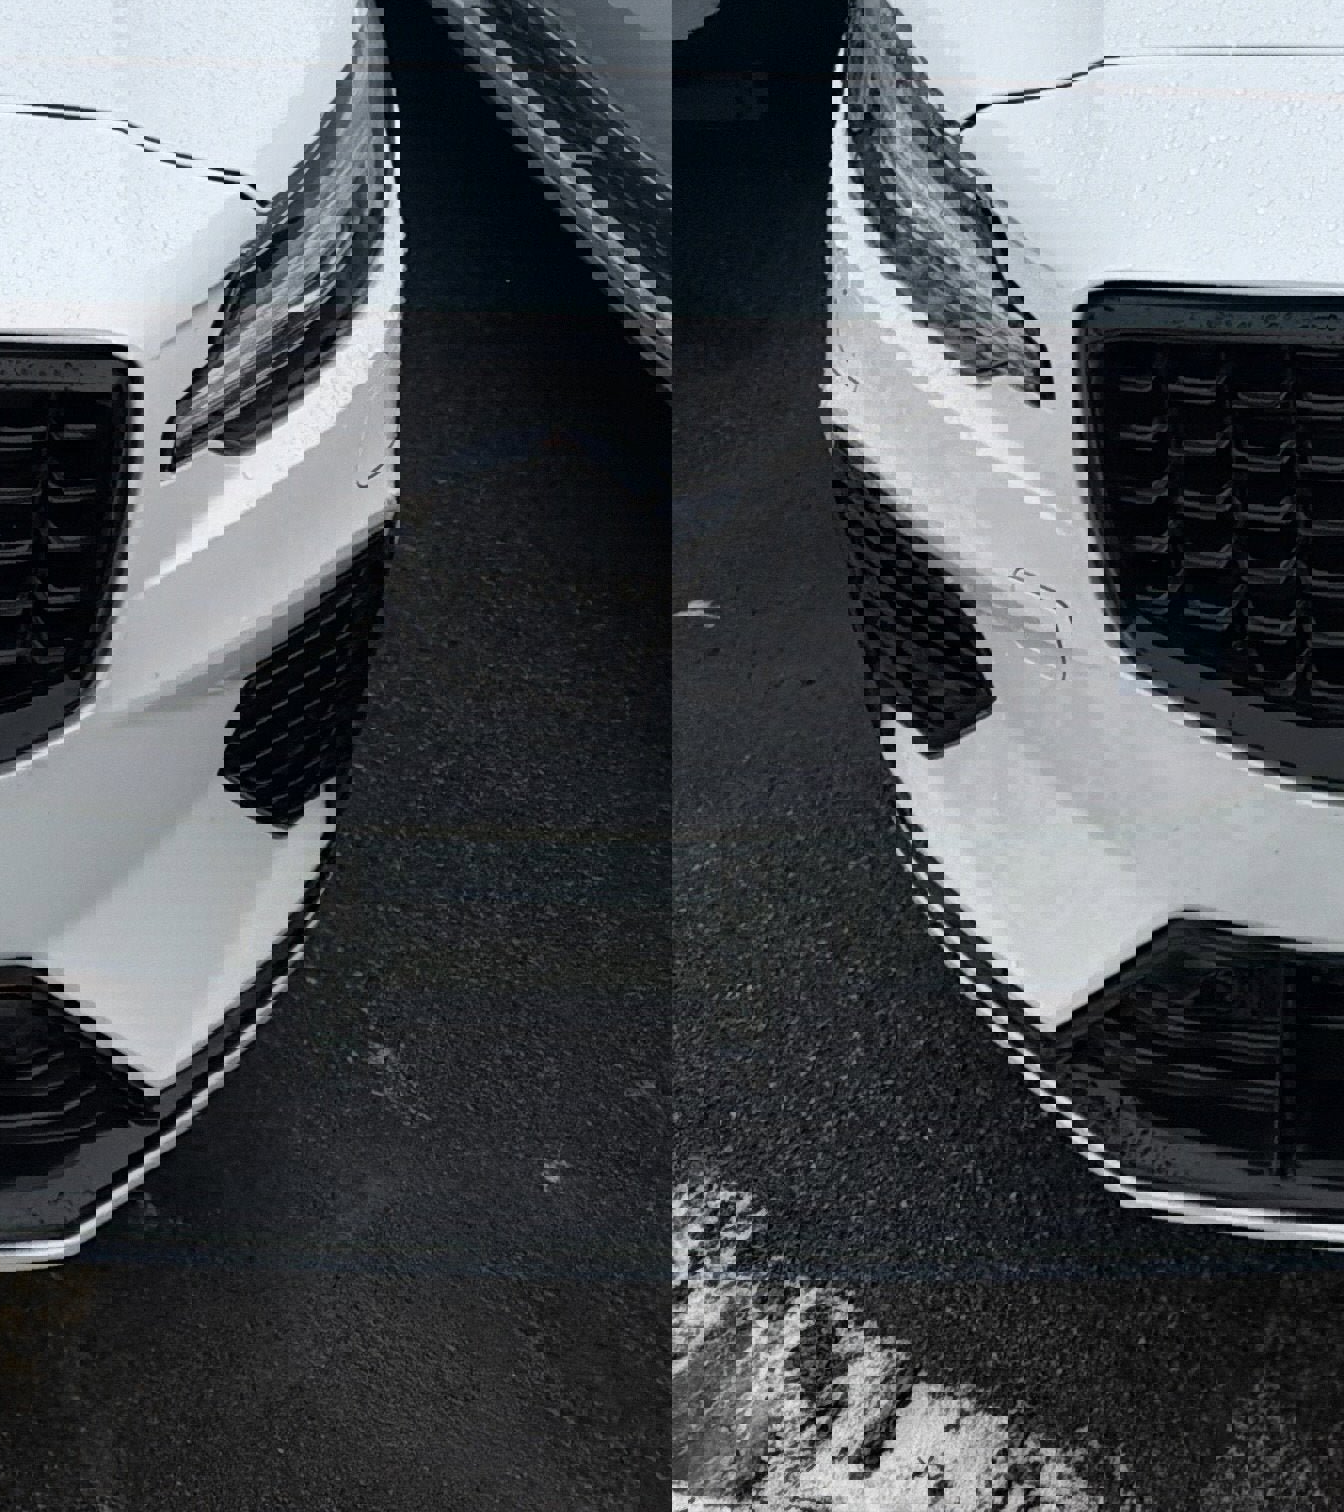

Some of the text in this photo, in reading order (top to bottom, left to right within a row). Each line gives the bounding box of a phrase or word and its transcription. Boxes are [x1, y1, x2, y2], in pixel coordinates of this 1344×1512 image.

[420, 567, 659, 605] VOLVO
[1131, 649, 1181, 660] Polestar
[1131, 661, 1199, 676] Engineered
